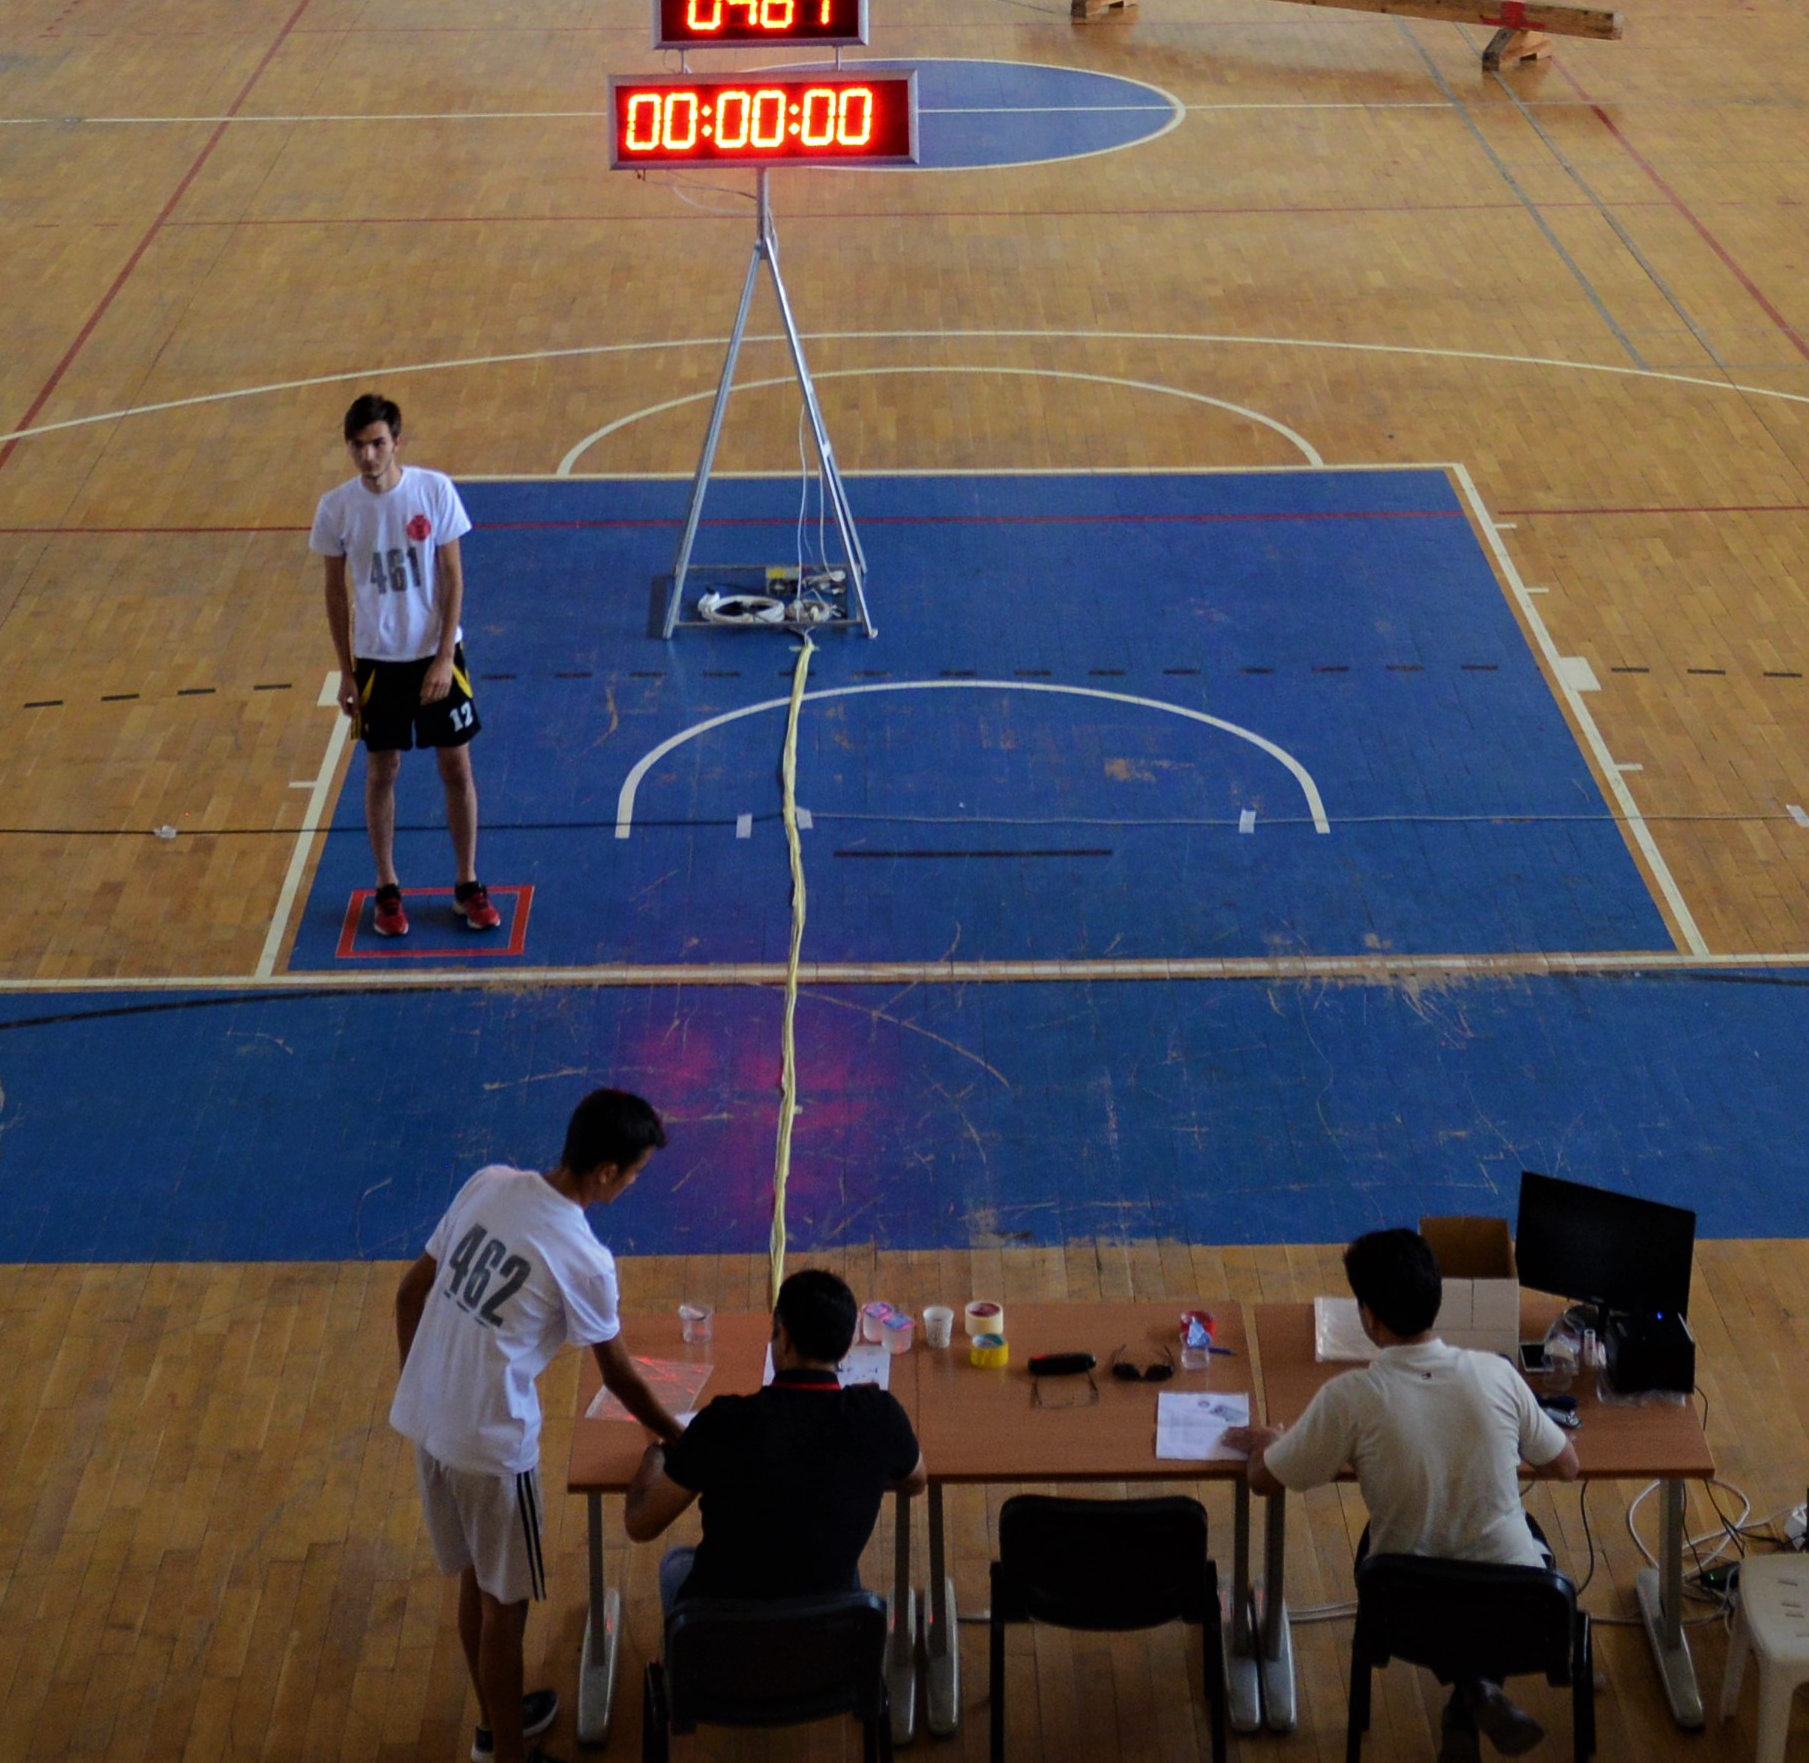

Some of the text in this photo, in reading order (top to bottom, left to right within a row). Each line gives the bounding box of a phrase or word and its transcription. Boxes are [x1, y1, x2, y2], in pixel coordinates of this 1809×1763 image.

[625, 87, 874, 151] 00:00:00
[369, 545, 422, 595] 461
[449, 701, 474, 733] 12
[447, 1222, 531, 1328] 462
